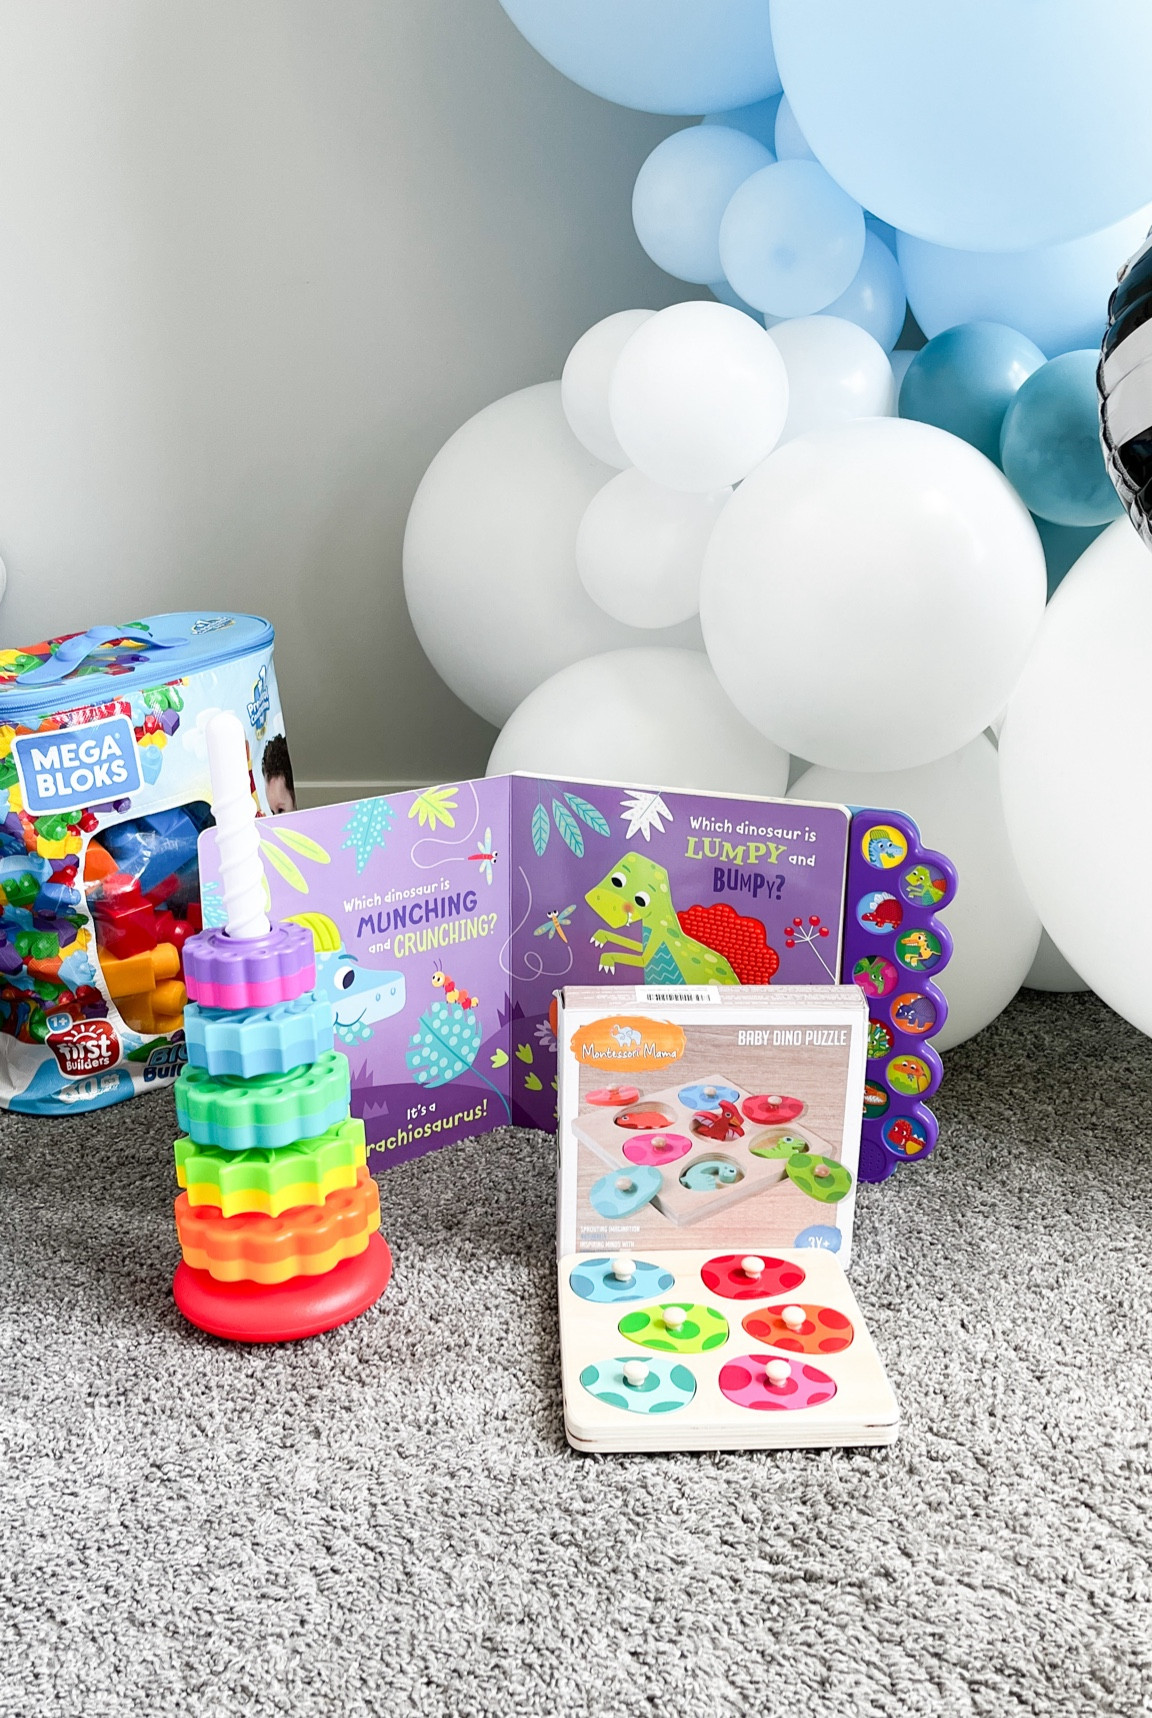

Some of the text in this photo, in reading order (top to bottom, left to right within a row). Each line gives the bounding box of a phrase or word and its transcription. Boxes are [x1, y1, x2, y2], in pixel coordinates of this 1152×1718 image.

[30, 735, 123, 771] MEGA
[36, 759, 128, 798] BLOKS
[689, 816, 817, 843] Which dinosaur is
[685, 836, 816, 867] LUMPY and
[343, 877, 450, 913] Which dinosaur is
[713, 867, 786, 901] BUMPY?
[356, 890, 478, 938] MUNCHING
[368, 912, 498, 959] and CRUNCHING?
[50, 1016, 68, 1028] 1+
[738, 1030, 847, 1046] BABY DINO PUZZLE
[66, 1057, 110, 1071] Builders
[582, 1043, 678, 1059] Montessori Mama
[407, 1102, 436, 1121] It's a
[366, 1098, 488, 1158] rachiosaurus!
